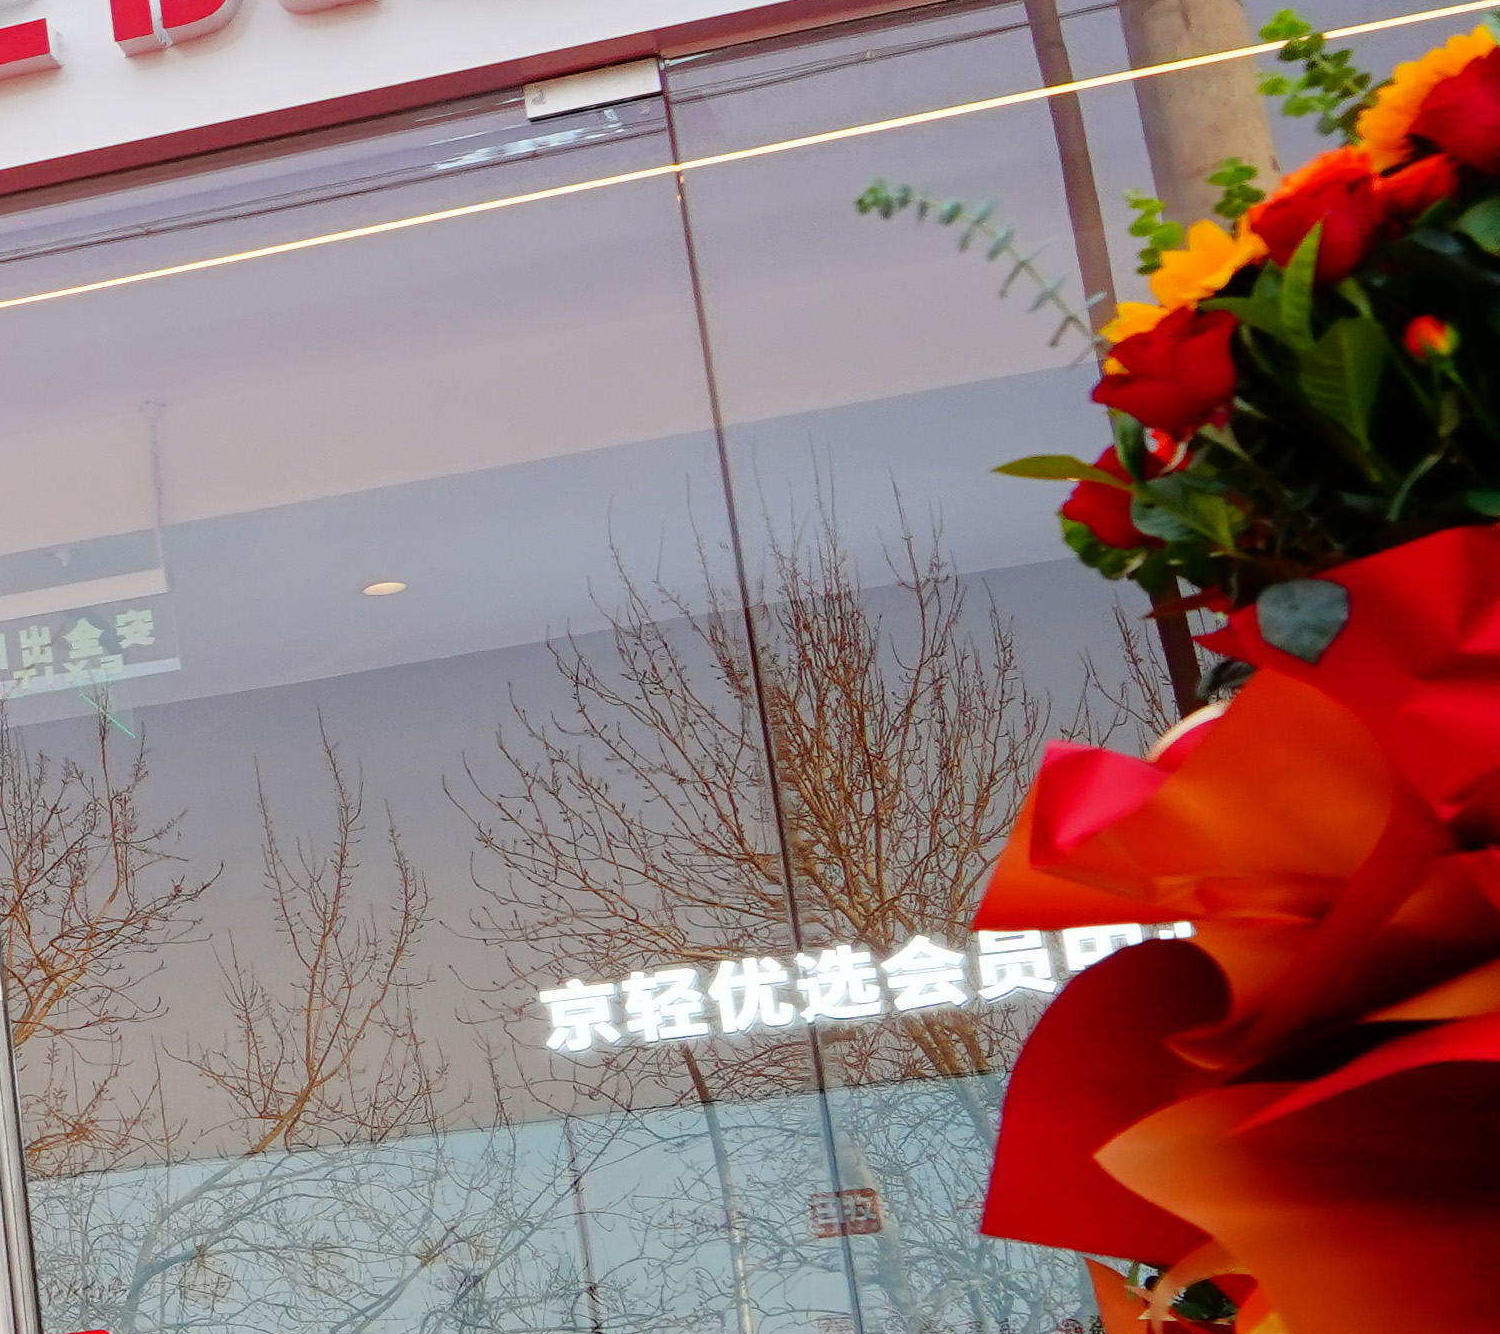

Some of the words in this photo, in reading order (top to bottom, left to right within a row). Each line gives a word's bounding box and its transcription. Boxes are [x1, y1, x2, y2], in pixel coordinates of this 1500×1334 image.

[538, 922, 1196, 1055] 京轻优选会员
